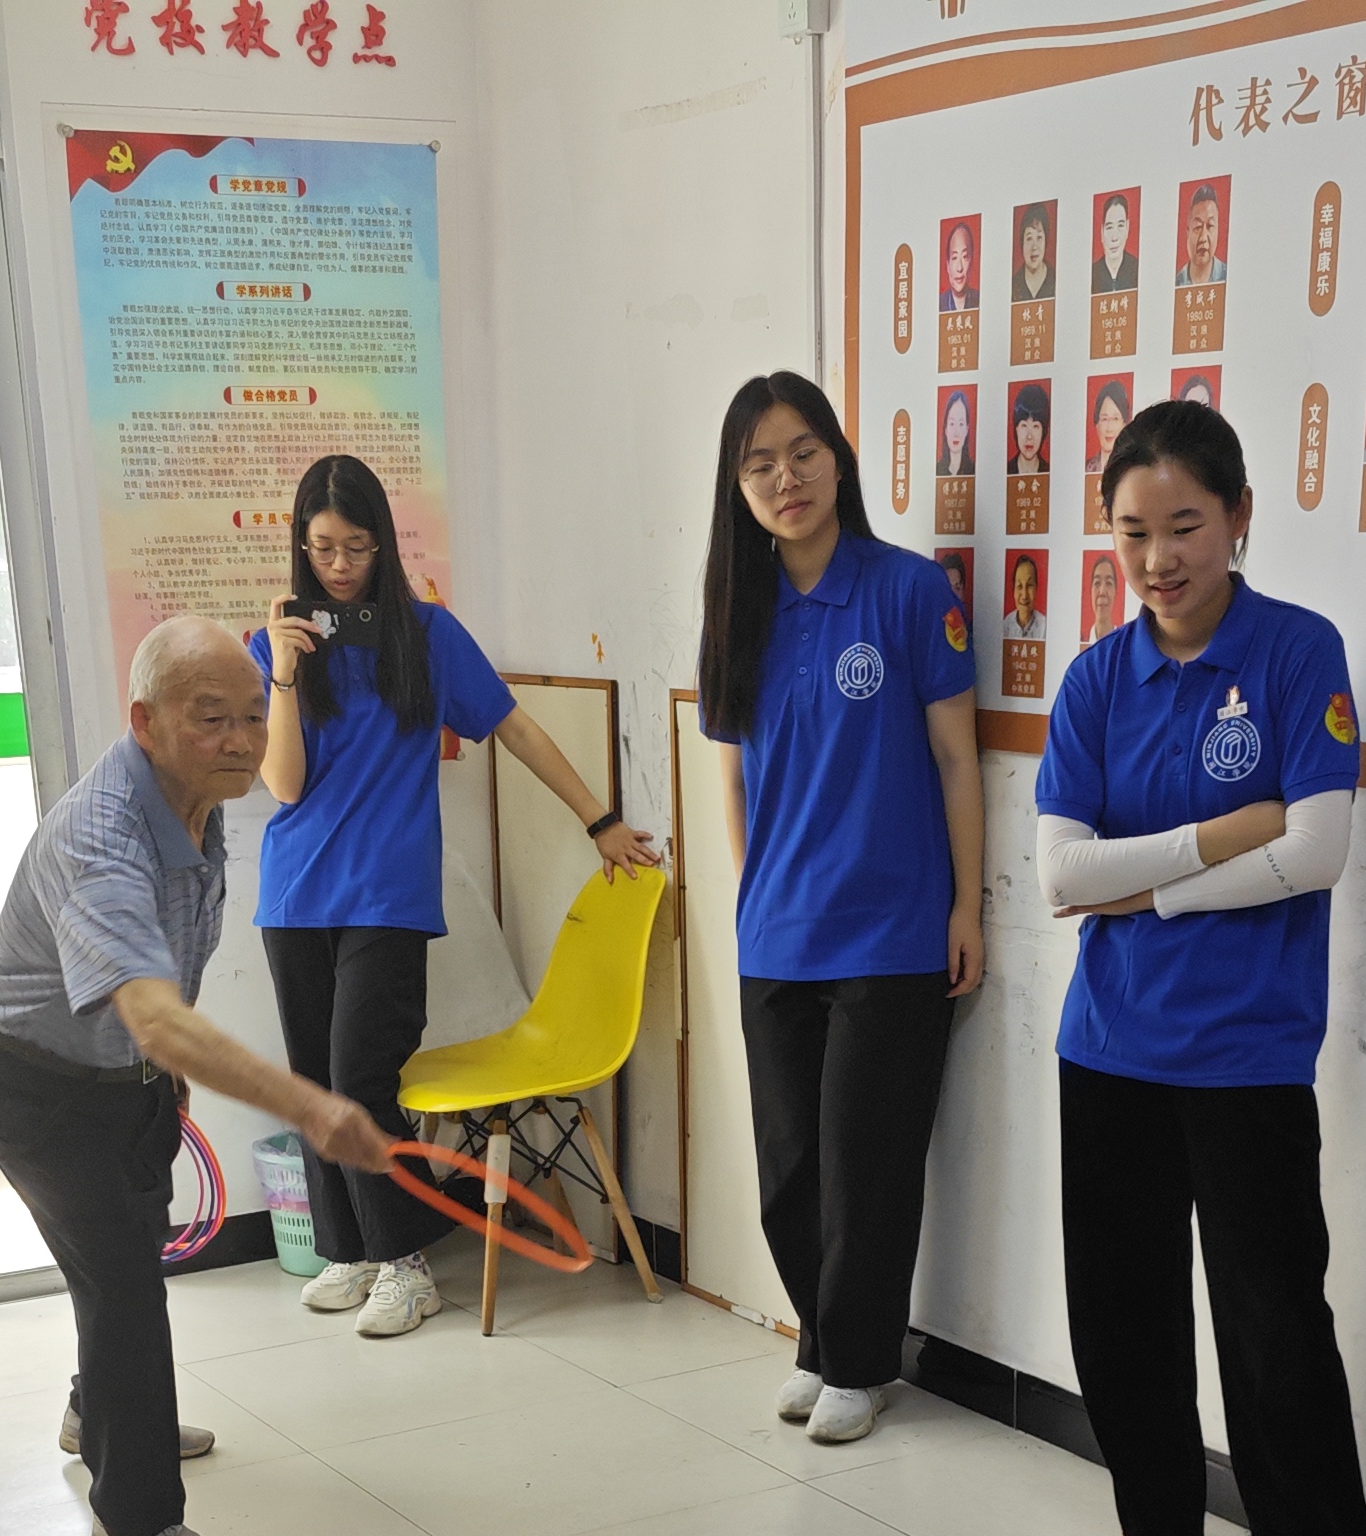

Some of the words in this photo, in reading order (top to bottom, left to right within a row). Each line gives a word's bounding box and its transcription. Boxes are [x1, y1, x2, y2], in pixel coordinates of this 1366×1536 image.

[84, 0, 396, 67] 党校教学点
[229, 179, 288, 193] 学党章党规
[1316, 203, 1334, 296] 幸福康乐
[235, 285, 294, 298] 学系列讲话
[898, 261, 908, 338] 宜居家园
[243, 389, 299, 402] 做合格党员
[896, 425, 907, 499] 志愿服务
[1303, 403, 1322, 492] 文化融合
